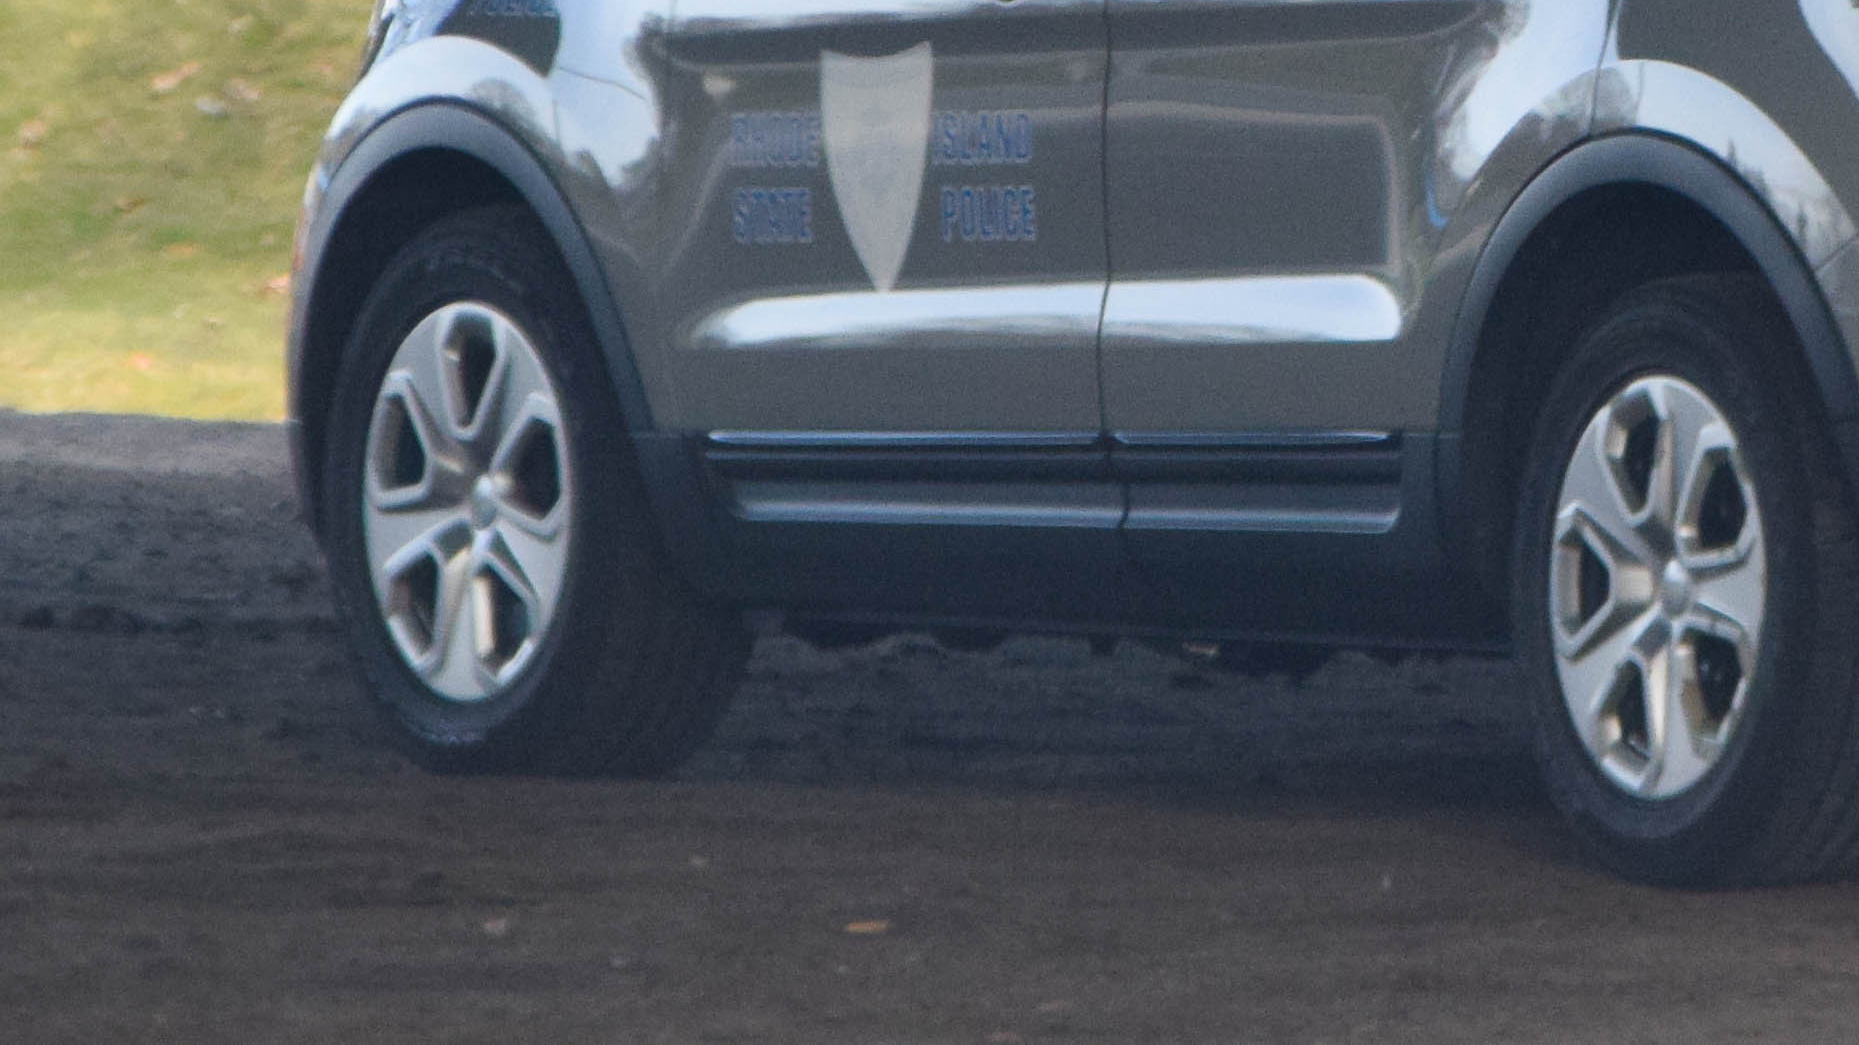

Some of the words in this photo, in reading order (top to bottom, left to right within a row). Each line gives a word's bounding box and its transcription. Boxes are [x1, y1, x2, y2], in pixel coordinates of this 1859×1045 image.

[931, 109, 1034, 164] ISLAND
[732, 186, 813, 243] STATE
[940, 184, 1037, 243] POLICE
